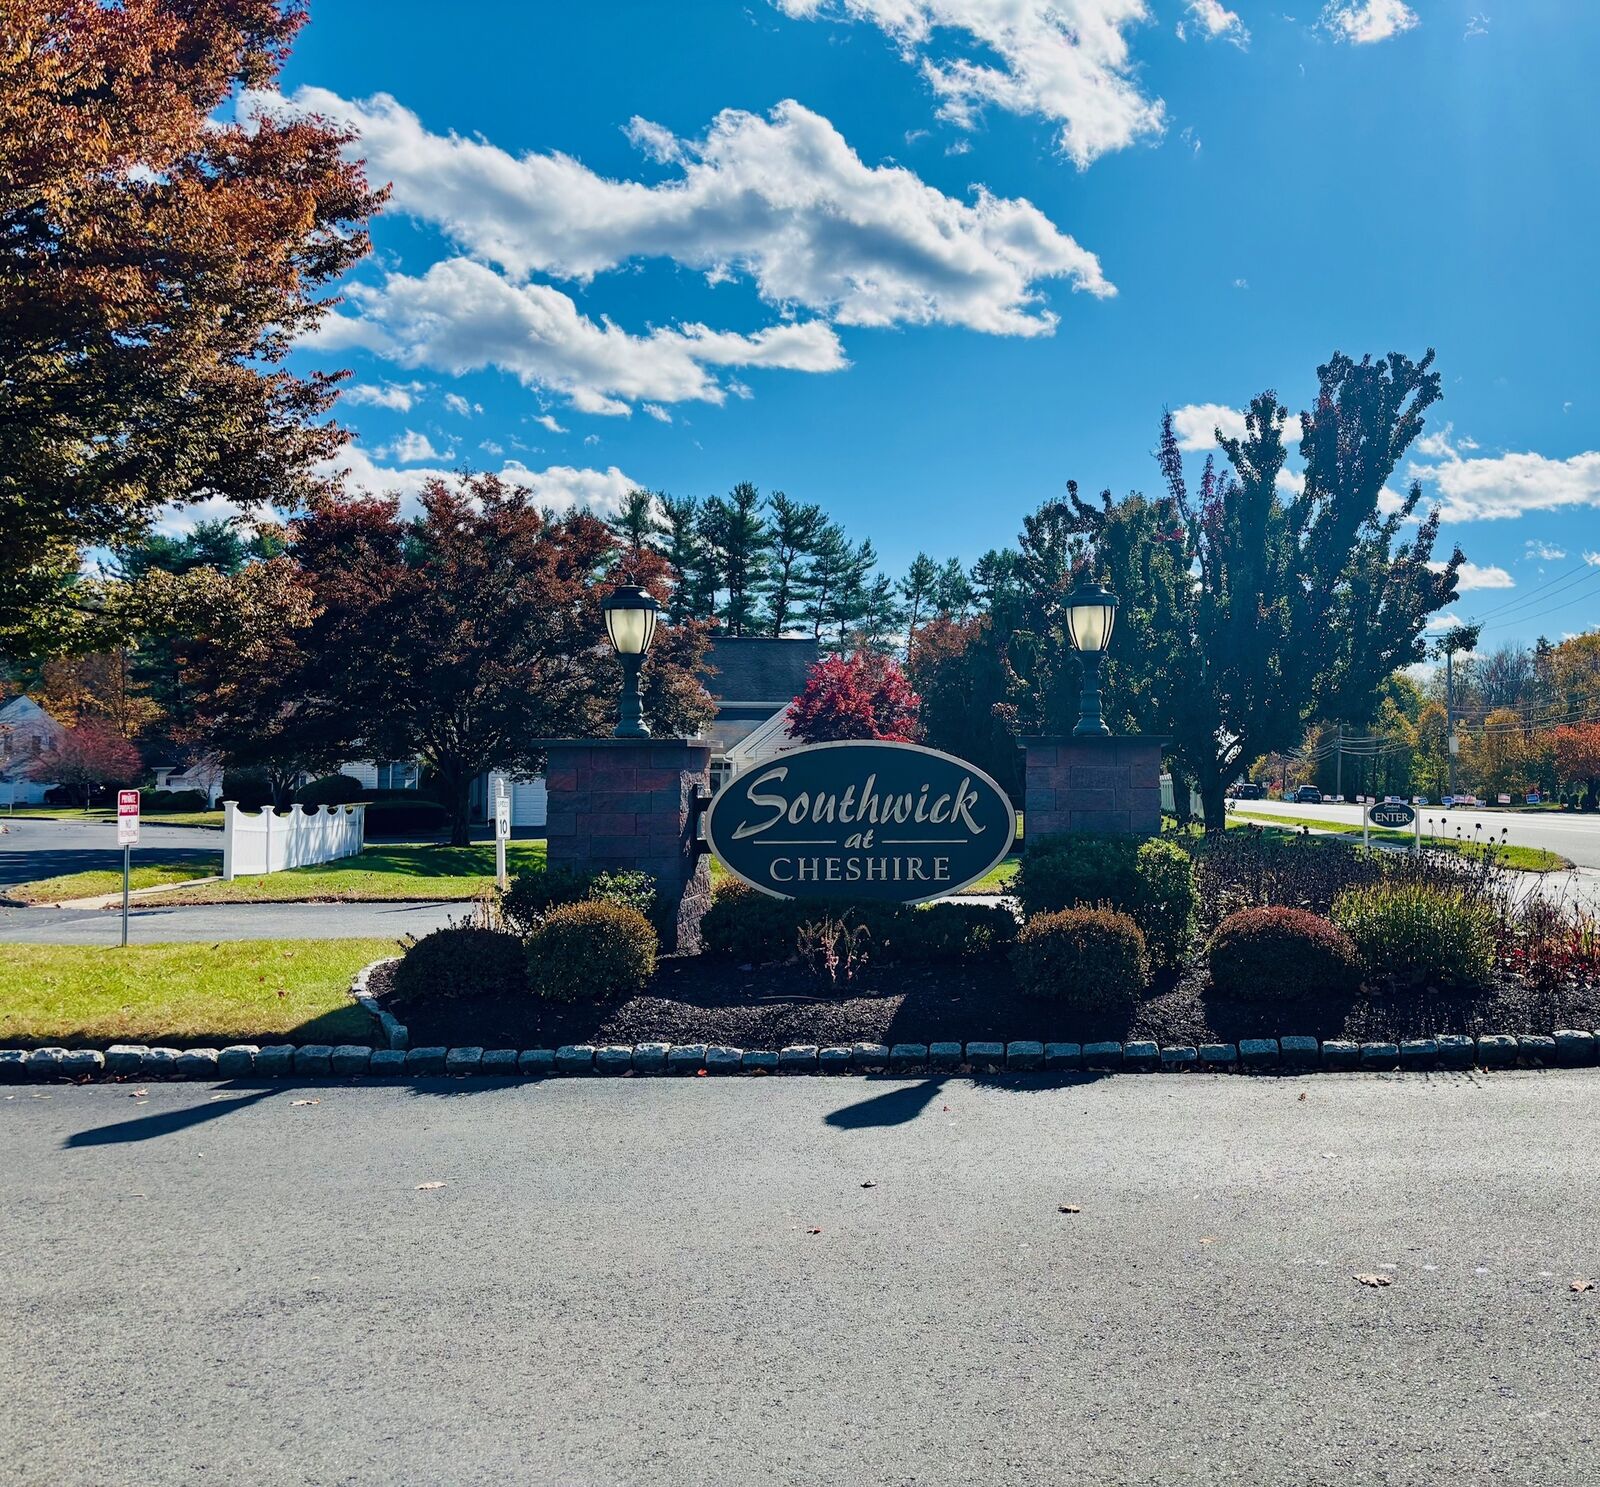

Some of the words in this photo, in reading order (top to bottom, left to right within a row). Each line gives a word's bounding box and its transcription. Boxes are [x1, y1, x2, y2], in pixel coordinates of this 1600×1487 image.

[732, 767, 986, 840] Southwick
[499, 819, 508, 834] 10
[1375, 812, 1410, 822] ENTER
[844, 829, 874, 849] at
[769, 857, 951, 881] CHESHIRE
